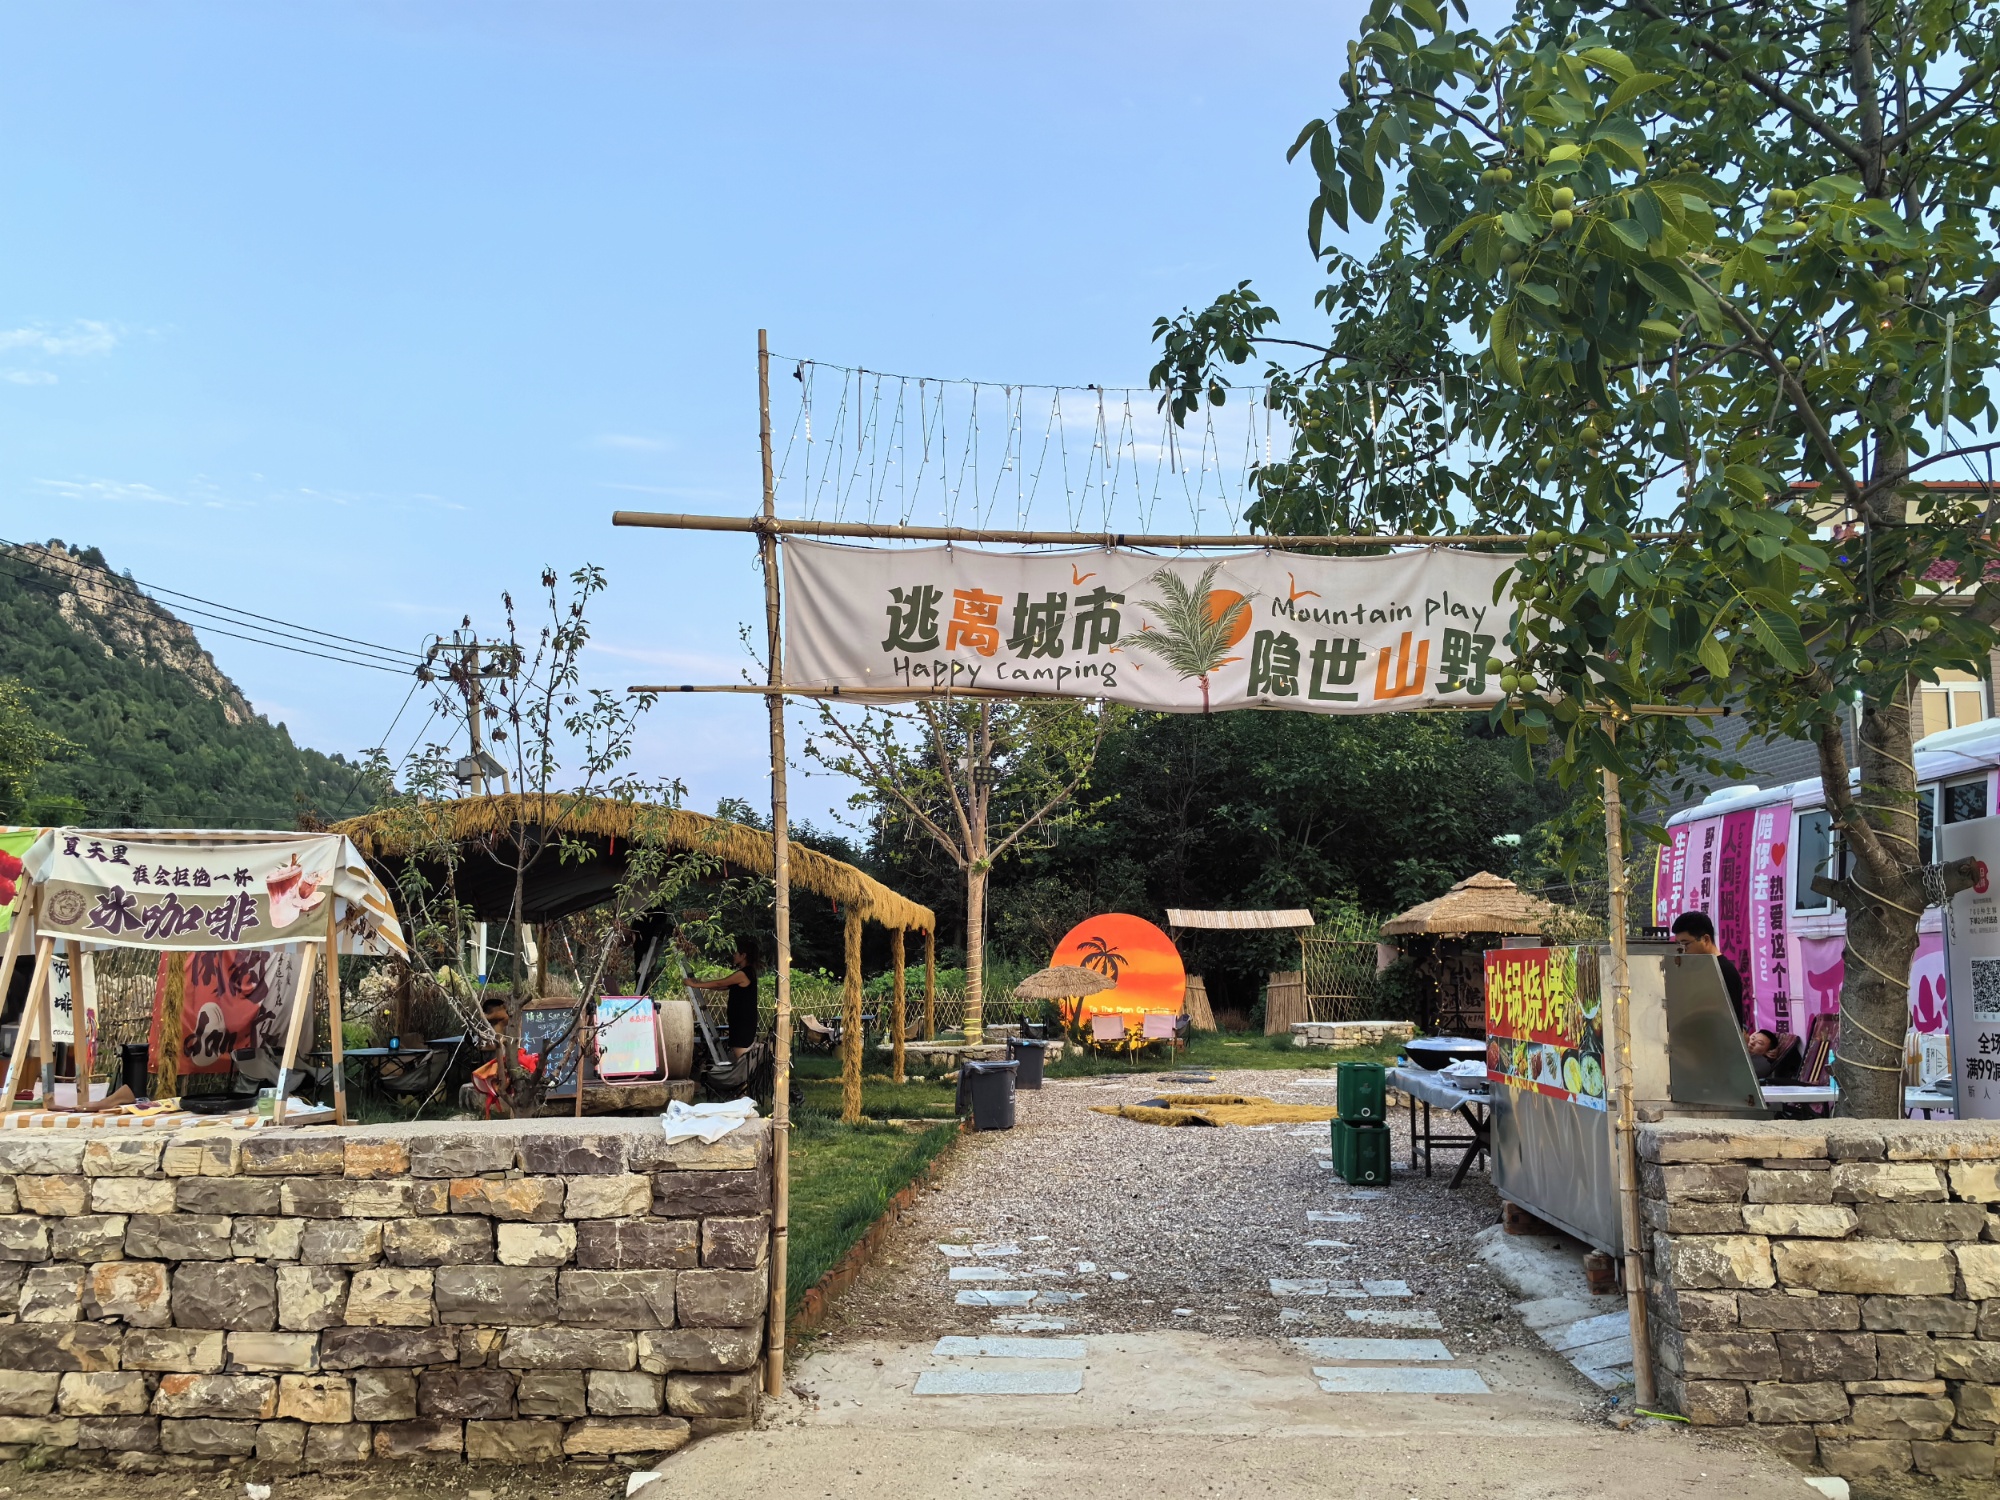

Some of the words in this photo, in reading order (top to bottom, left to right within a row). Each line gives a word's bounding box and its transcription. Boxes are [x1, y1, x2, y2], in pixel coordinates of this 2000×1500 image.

[882, 584, 1126, 660] 逃离城市
[1271, 596, 1413, 625] Mountain
[893, 655, 982, 688] Happy
[1246, 627, 1497, 702] 隐世山野
[62, 835, 131, 866] 夏天里
[1661, 846, 1671, 875] IVE
[1754, 812, 1774, 901] 陪你去
[132, 864, 254, 888] 谁会拒绝一杯
[82, 884, 262, 943] 冰咖啡
[1759, 945, 1768, 981] YOU
[1487, 958, 1564, 1036] 砂锅烧烤
